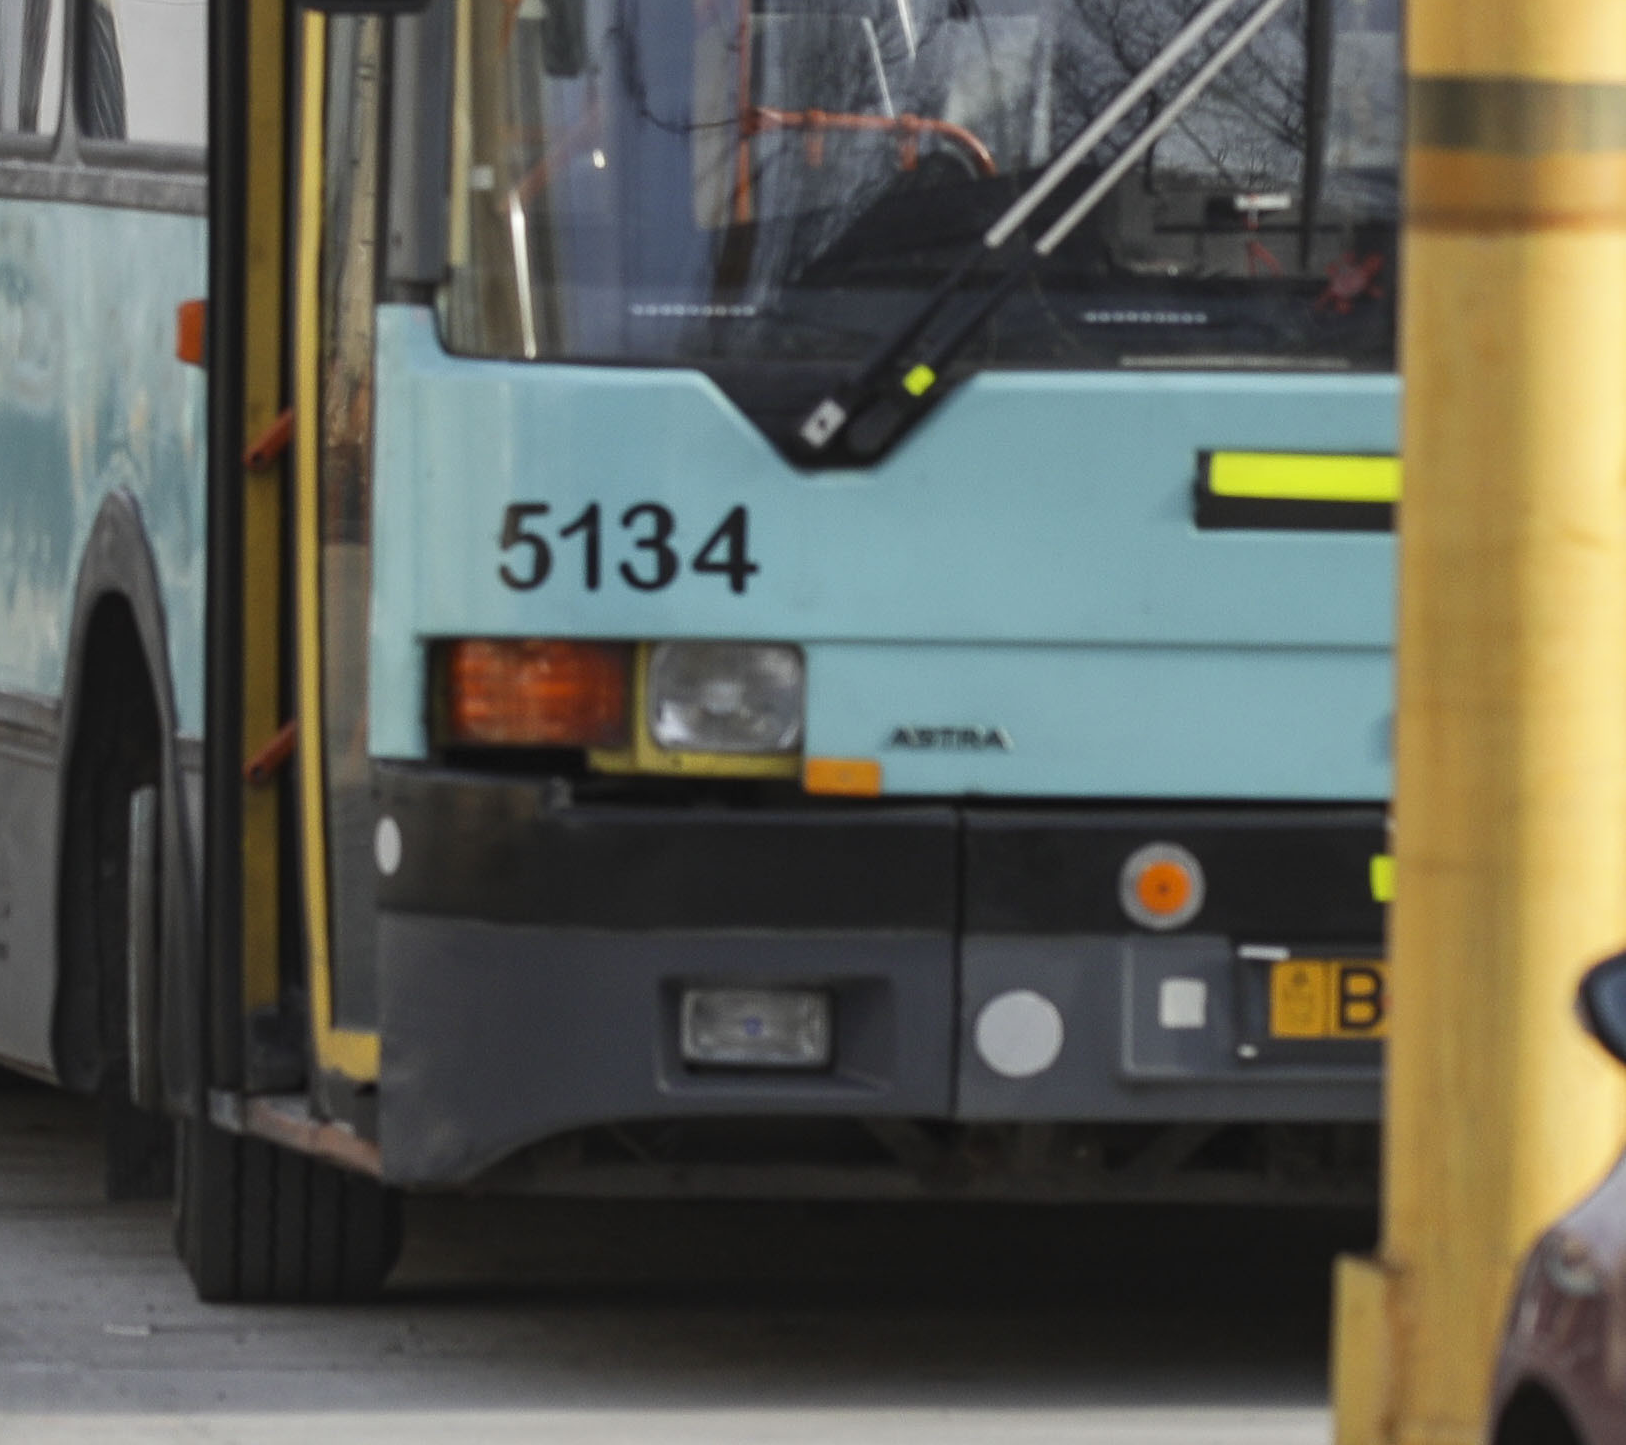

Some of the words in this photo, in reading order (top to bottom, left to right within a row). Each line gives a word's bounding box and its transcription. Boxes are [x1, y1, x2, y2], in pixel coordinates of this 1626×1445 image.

[499, 500, 760, 594] 5134
[886, 725, 1009, 752] ASTRA
[1340, 967, 1383, 1029] B
